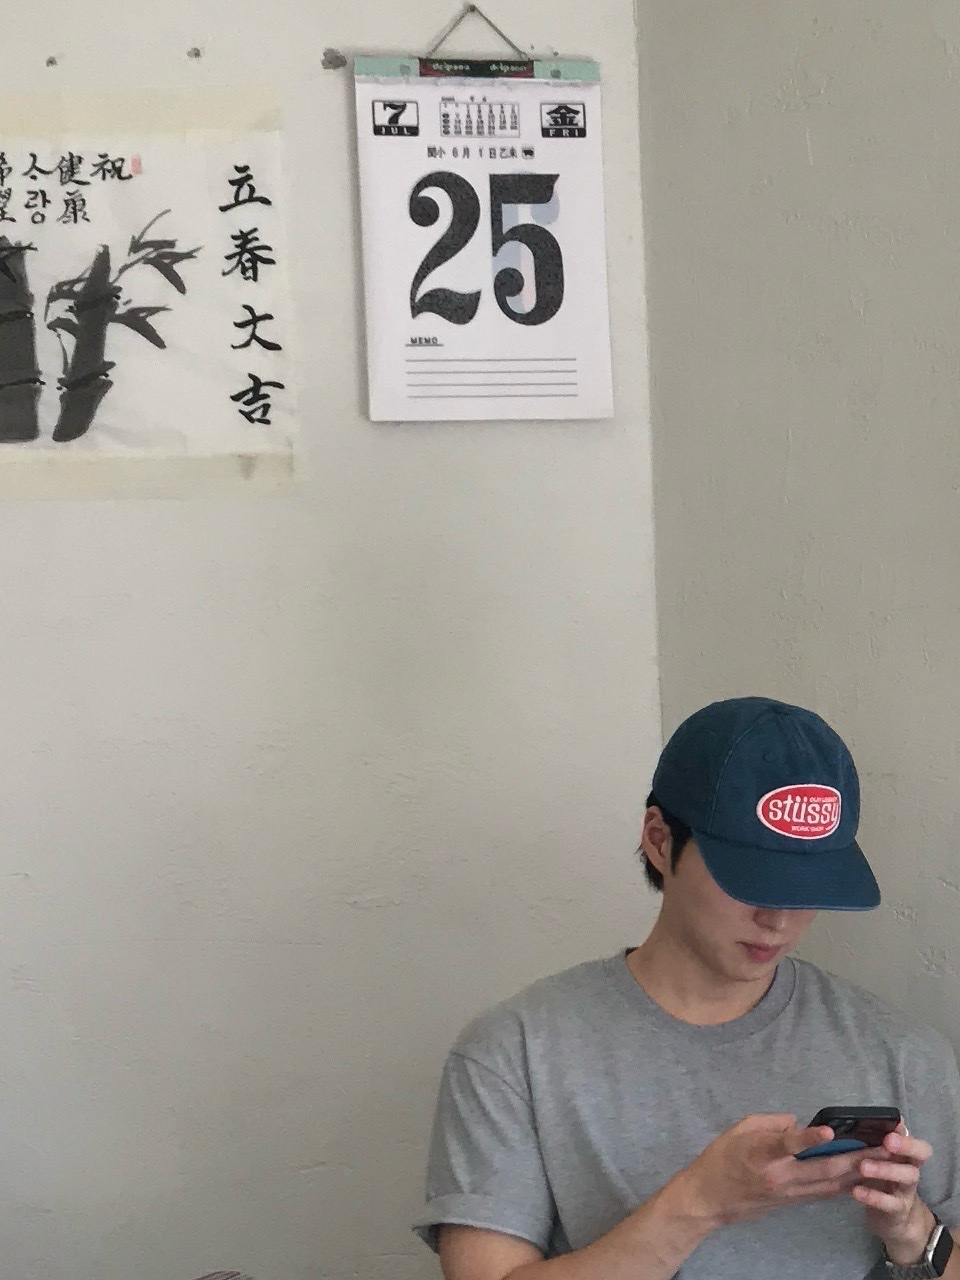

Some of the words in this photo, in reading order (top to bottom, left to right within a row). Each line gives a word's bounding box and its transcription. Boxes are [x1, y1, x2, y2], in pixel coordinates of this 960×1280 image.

[383, 101, 407, 125] 7
[546, 105, 581, 127] 金
[381, 126, 411, 135] JUL
[549, 128, 579, 137] FRI
[408, 170, 566, 327] 25
[410, 336, 439, 345] MEMO
